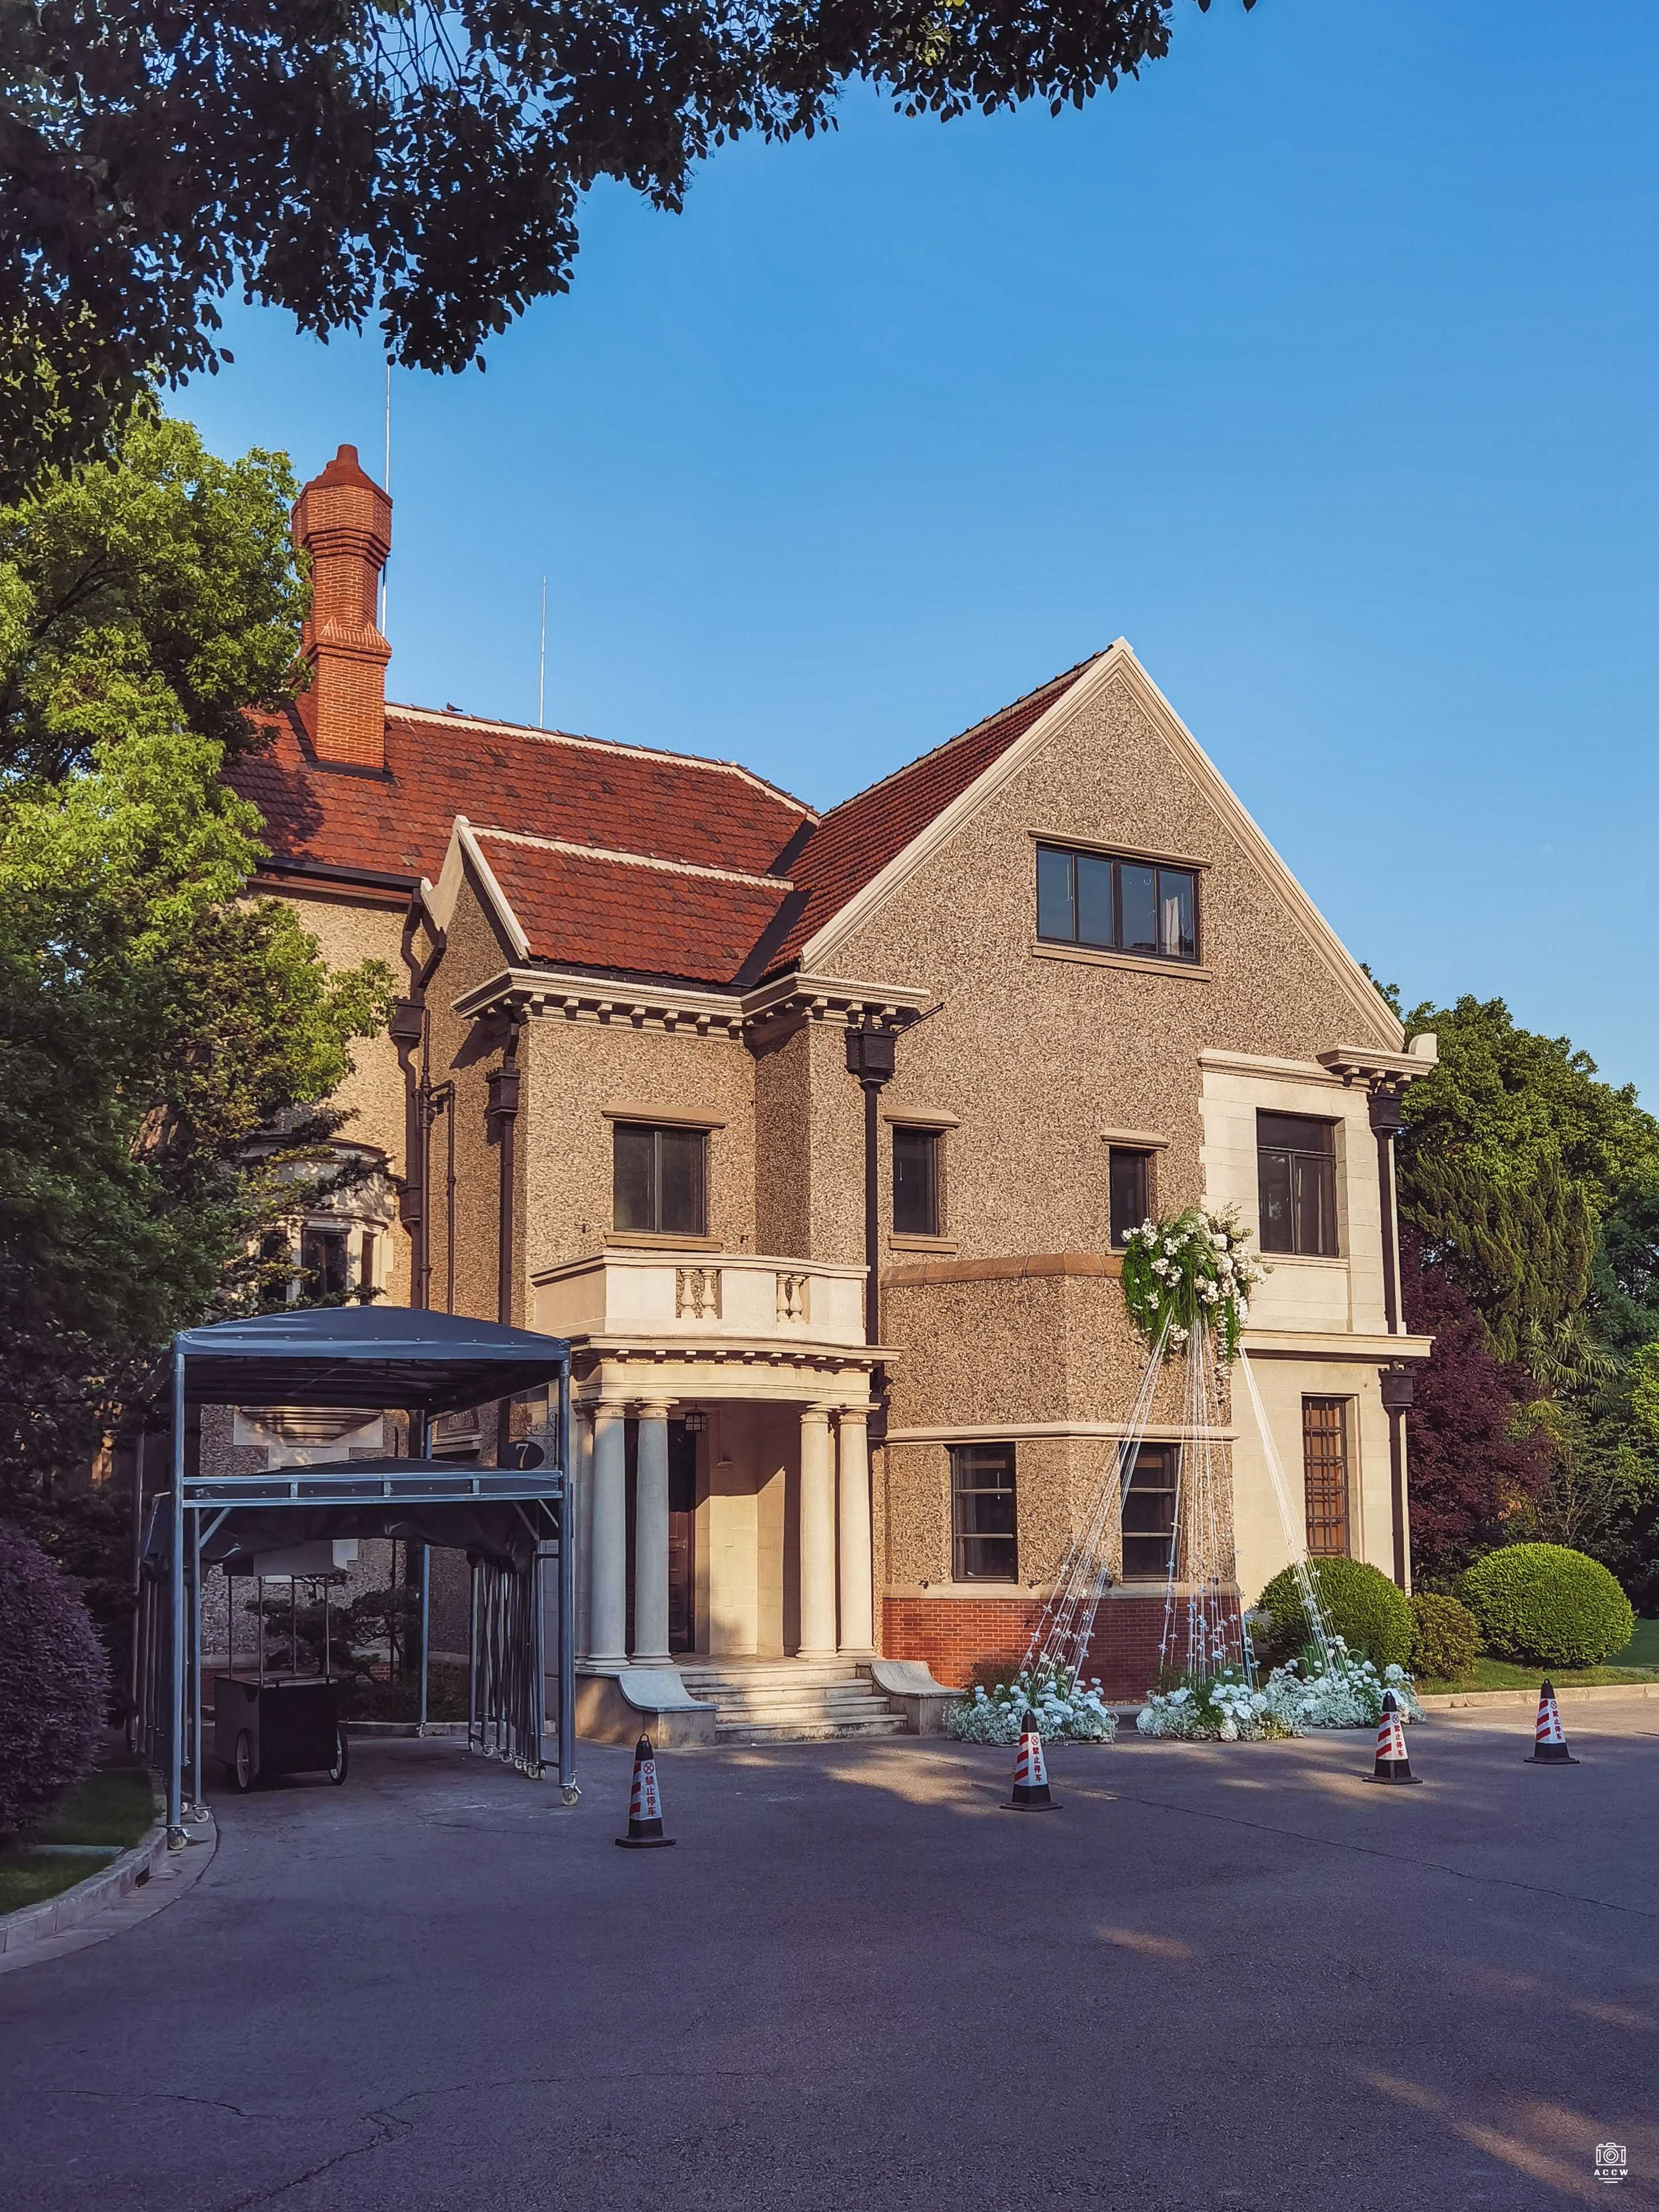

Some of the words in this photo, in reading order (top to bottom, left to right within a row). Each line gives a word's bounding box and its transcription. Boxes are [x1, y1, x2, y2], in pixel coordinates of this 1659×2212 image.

[516, 1443, 529, 1469] 7
[1032, 1747, 1042, 1782] 禁止停车
[645, 1775, 657, 1816] 禁止停车
